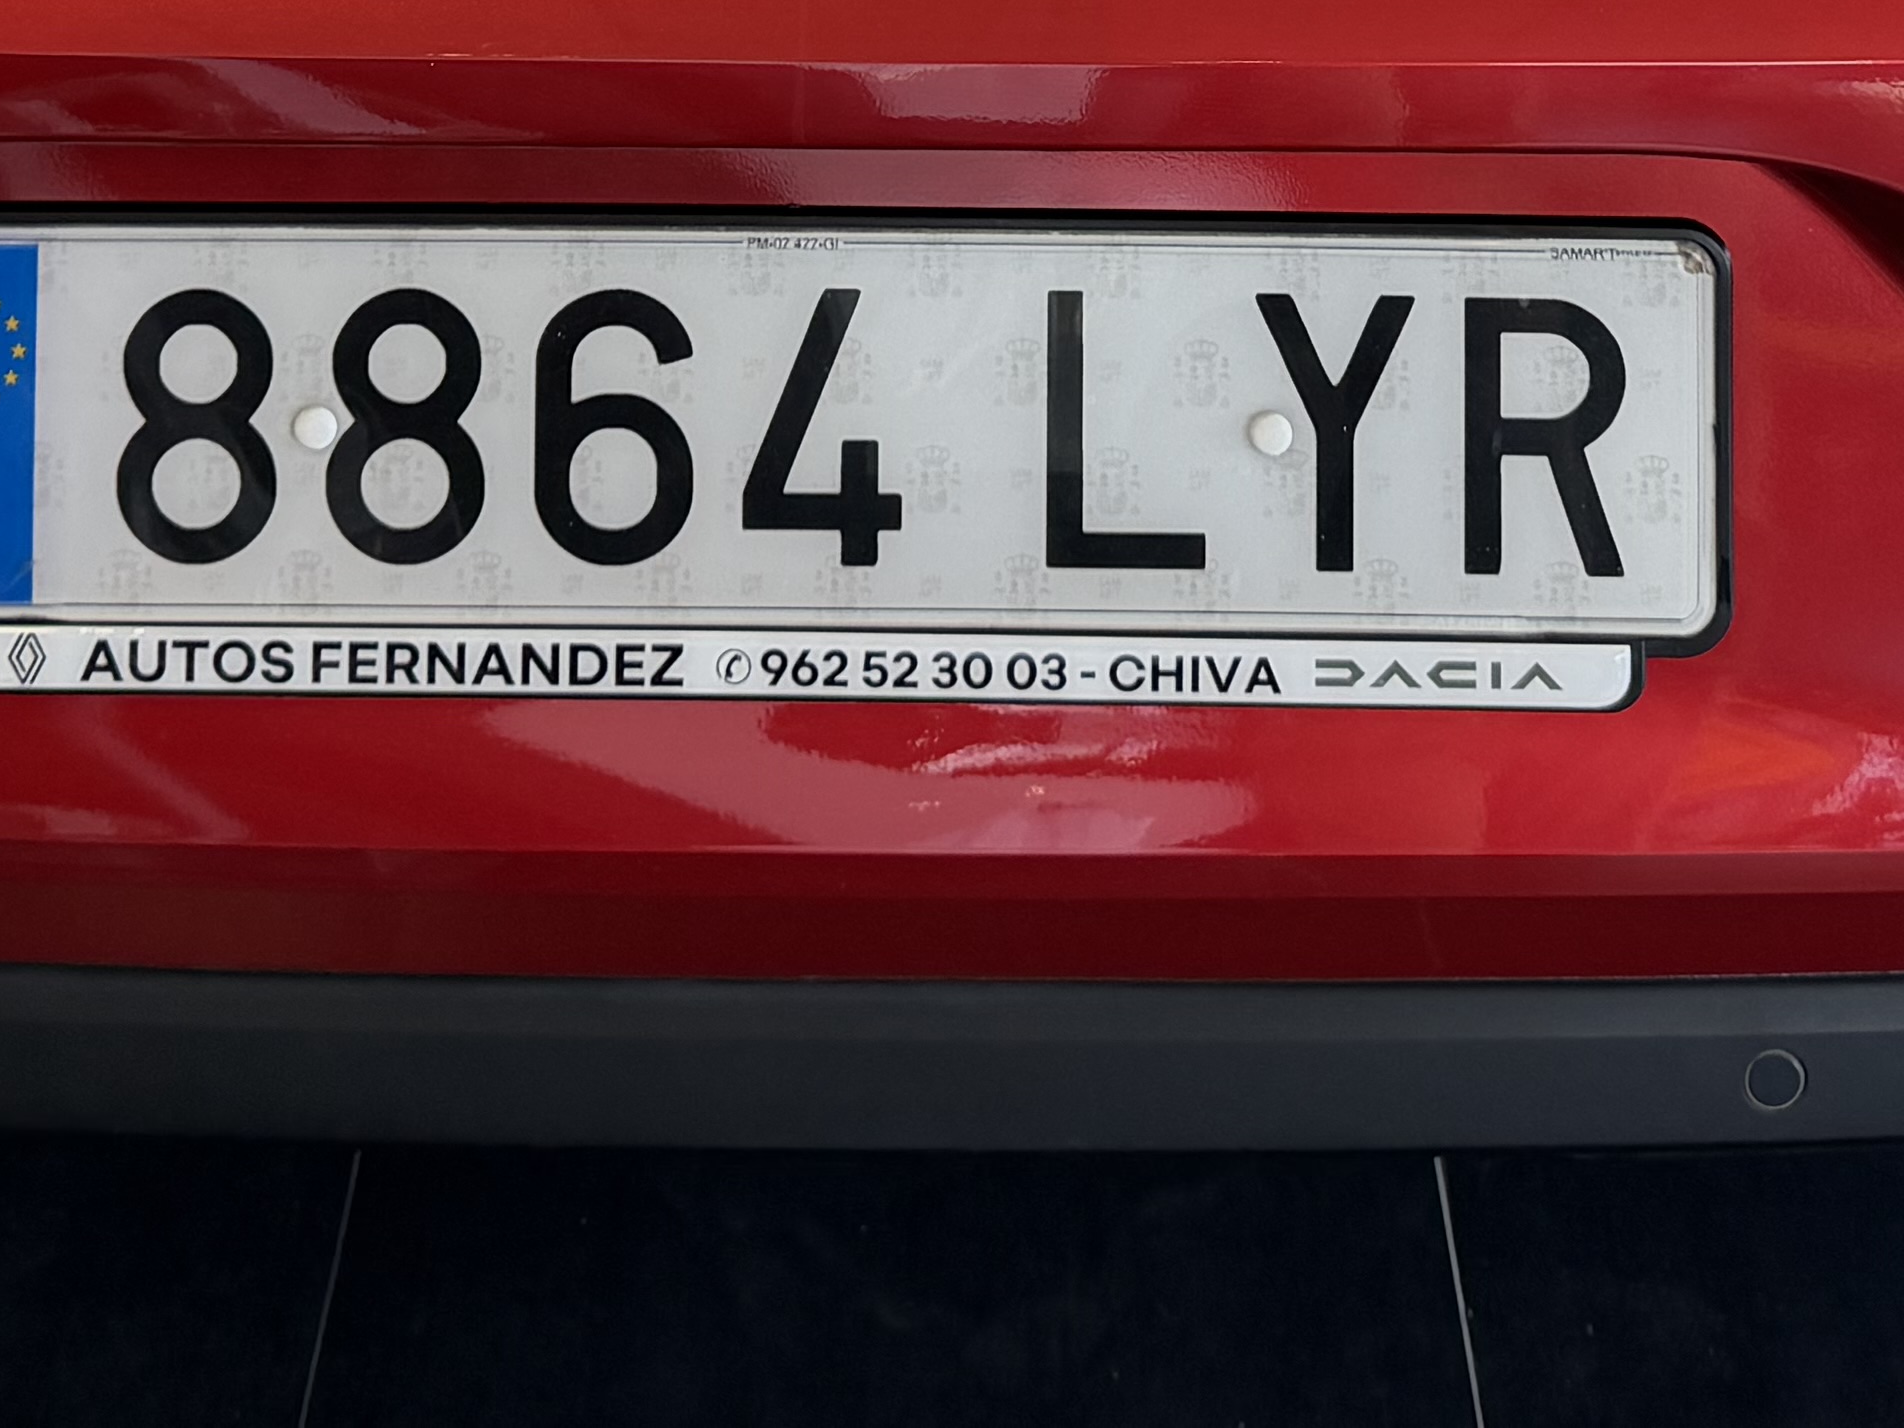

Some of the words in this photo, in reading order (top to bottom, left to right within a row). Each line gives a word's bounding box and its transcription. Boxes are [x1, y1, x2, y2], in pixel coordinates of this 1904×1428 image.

[116, 287, 903, 567] 8864
[1045, 290, 1626, 578] LYR
[80, 638, 295, 685] AUTOS
[310, 641, 685, 688] FERNANDEZ
[759, 648, 850, 689] 962
[861, 650, 919, 689] 52
[931, 652, 994, 690] 30
[1005, 653, 1068, 692] 03
[1108, 655, 1282, 695] CHIVA
[1314, 659, 1563, 691] DACIA
